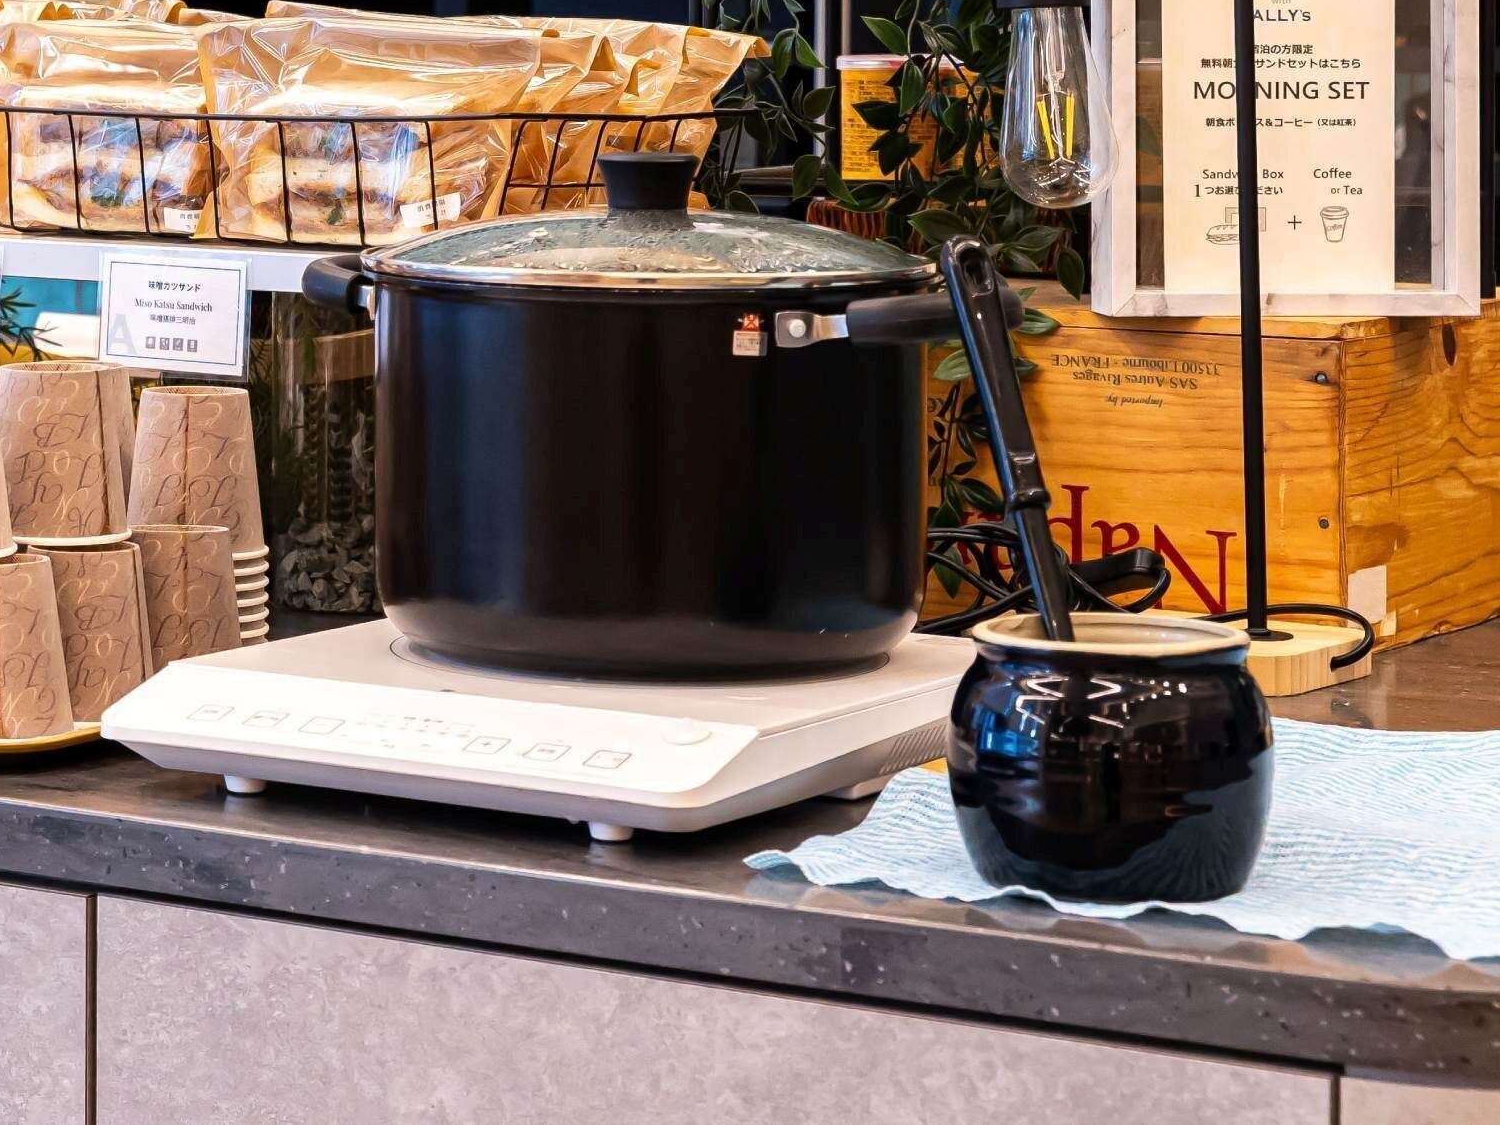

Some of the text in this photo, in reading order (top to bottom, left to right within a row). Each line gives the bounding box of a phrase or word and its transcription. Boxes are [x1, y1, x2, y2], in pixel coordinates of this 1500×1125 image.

[1201, 58, 1361, 69] 無料朝サンドセットはこちら
[1193, 81, 1370, 100] MONING SET
[1262, 169, 1284, 179] Box
[1313, 168, 1352, 179] Coffee
[1330, 185, 1363, 195] or Tea
[134, 298, 213, 312] Miso Katsu Sandwich
[1051, 354, 1110, 369] FRANCE
[1182, 362, 1220, 376] 33500
[1072, 370, 1198, 390] SAS Autres Rivages
